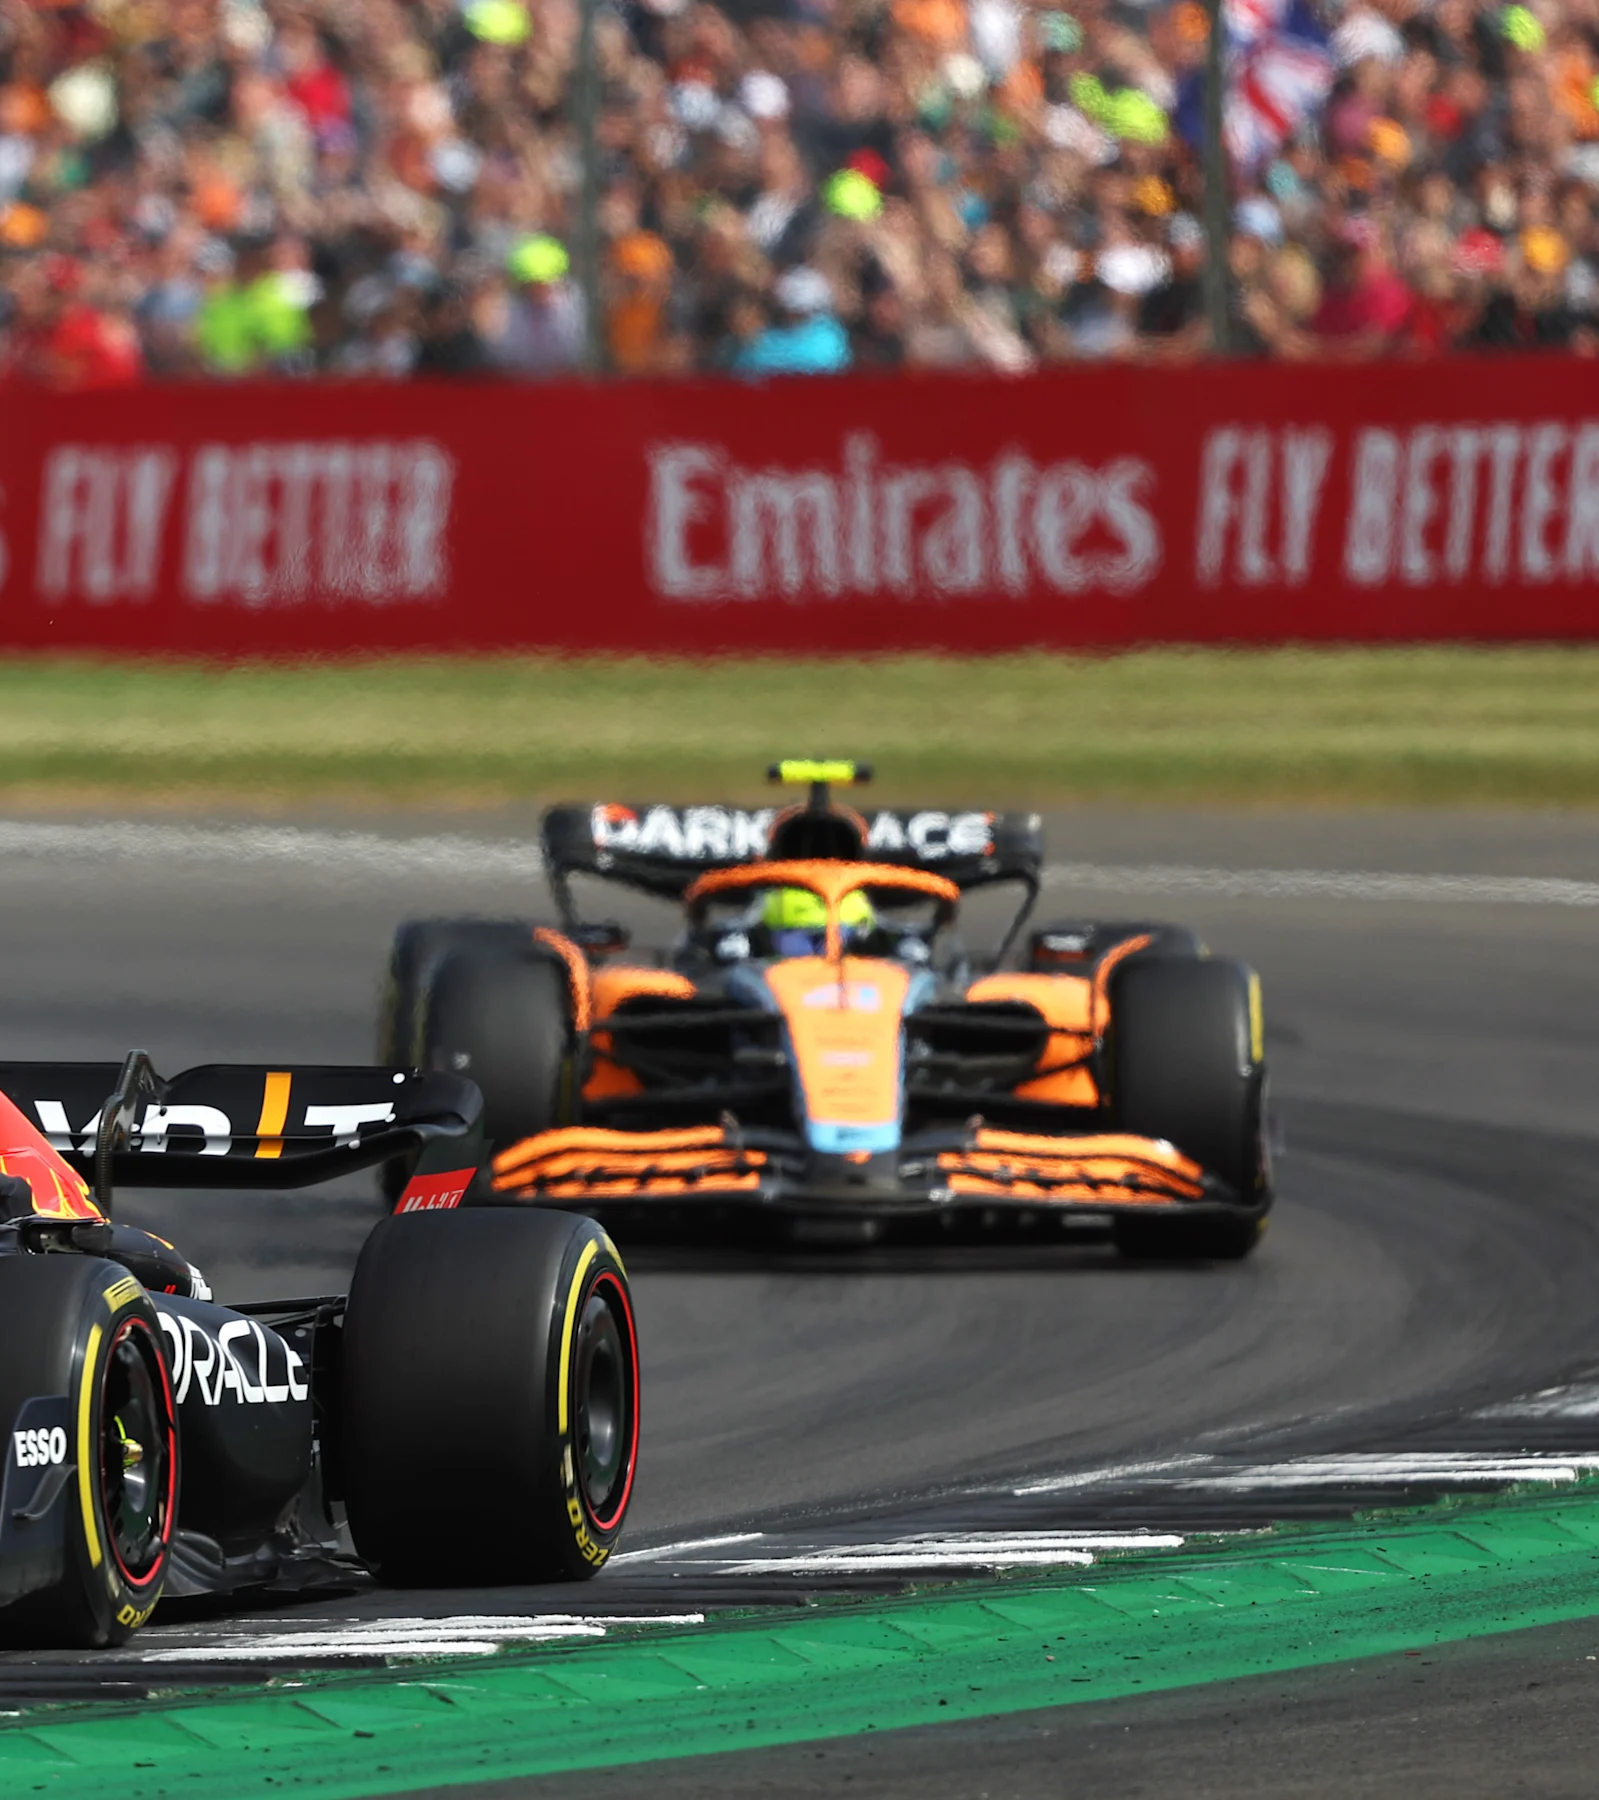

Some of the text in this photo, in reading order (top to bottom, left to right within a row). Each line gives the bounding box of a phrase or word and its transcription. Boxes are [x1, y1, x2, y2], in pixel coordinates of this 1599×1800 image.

[41, 447, 176, 601] FLY
[184, 441, 454, 606] BETTER
[647, 433, 1160, 600] Emirates
[1197, 427, 1331, 583] FLY
[13, 1426, 67, 1467] ESSO
[567, 1497, 608, 1567] ZERO
